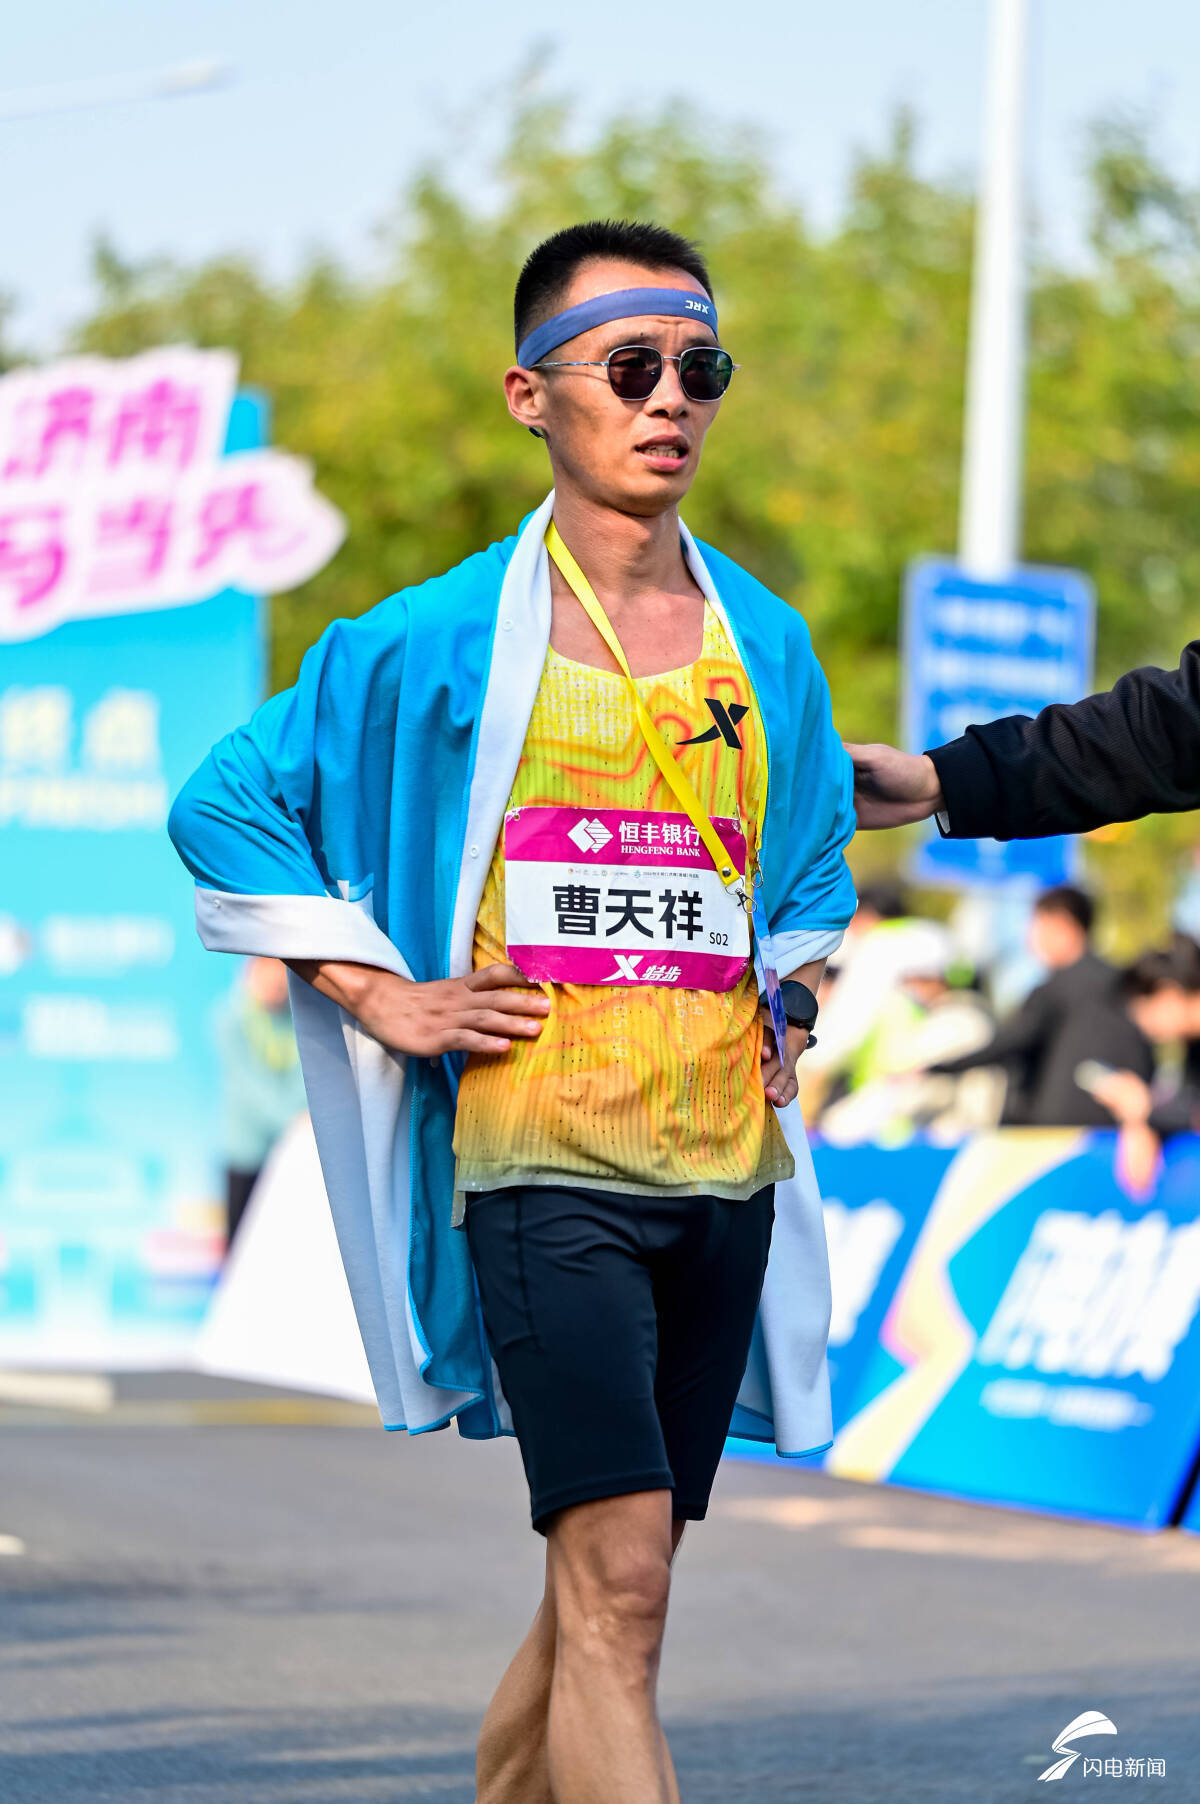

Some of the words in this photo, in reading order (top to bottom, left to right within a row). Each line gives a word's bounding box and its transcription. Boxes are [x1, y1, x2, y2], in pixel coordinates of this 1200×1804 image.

[685, 299, 709, 314] XRC
[618, 820, 701, 846] 恒丰银行
[620, 845, 674, 856] HENGFENG
[676, 847, 701, 857] BANK
[552, 884, 704, 941] 曹天祥
[709, 931, 729, 947] S02
